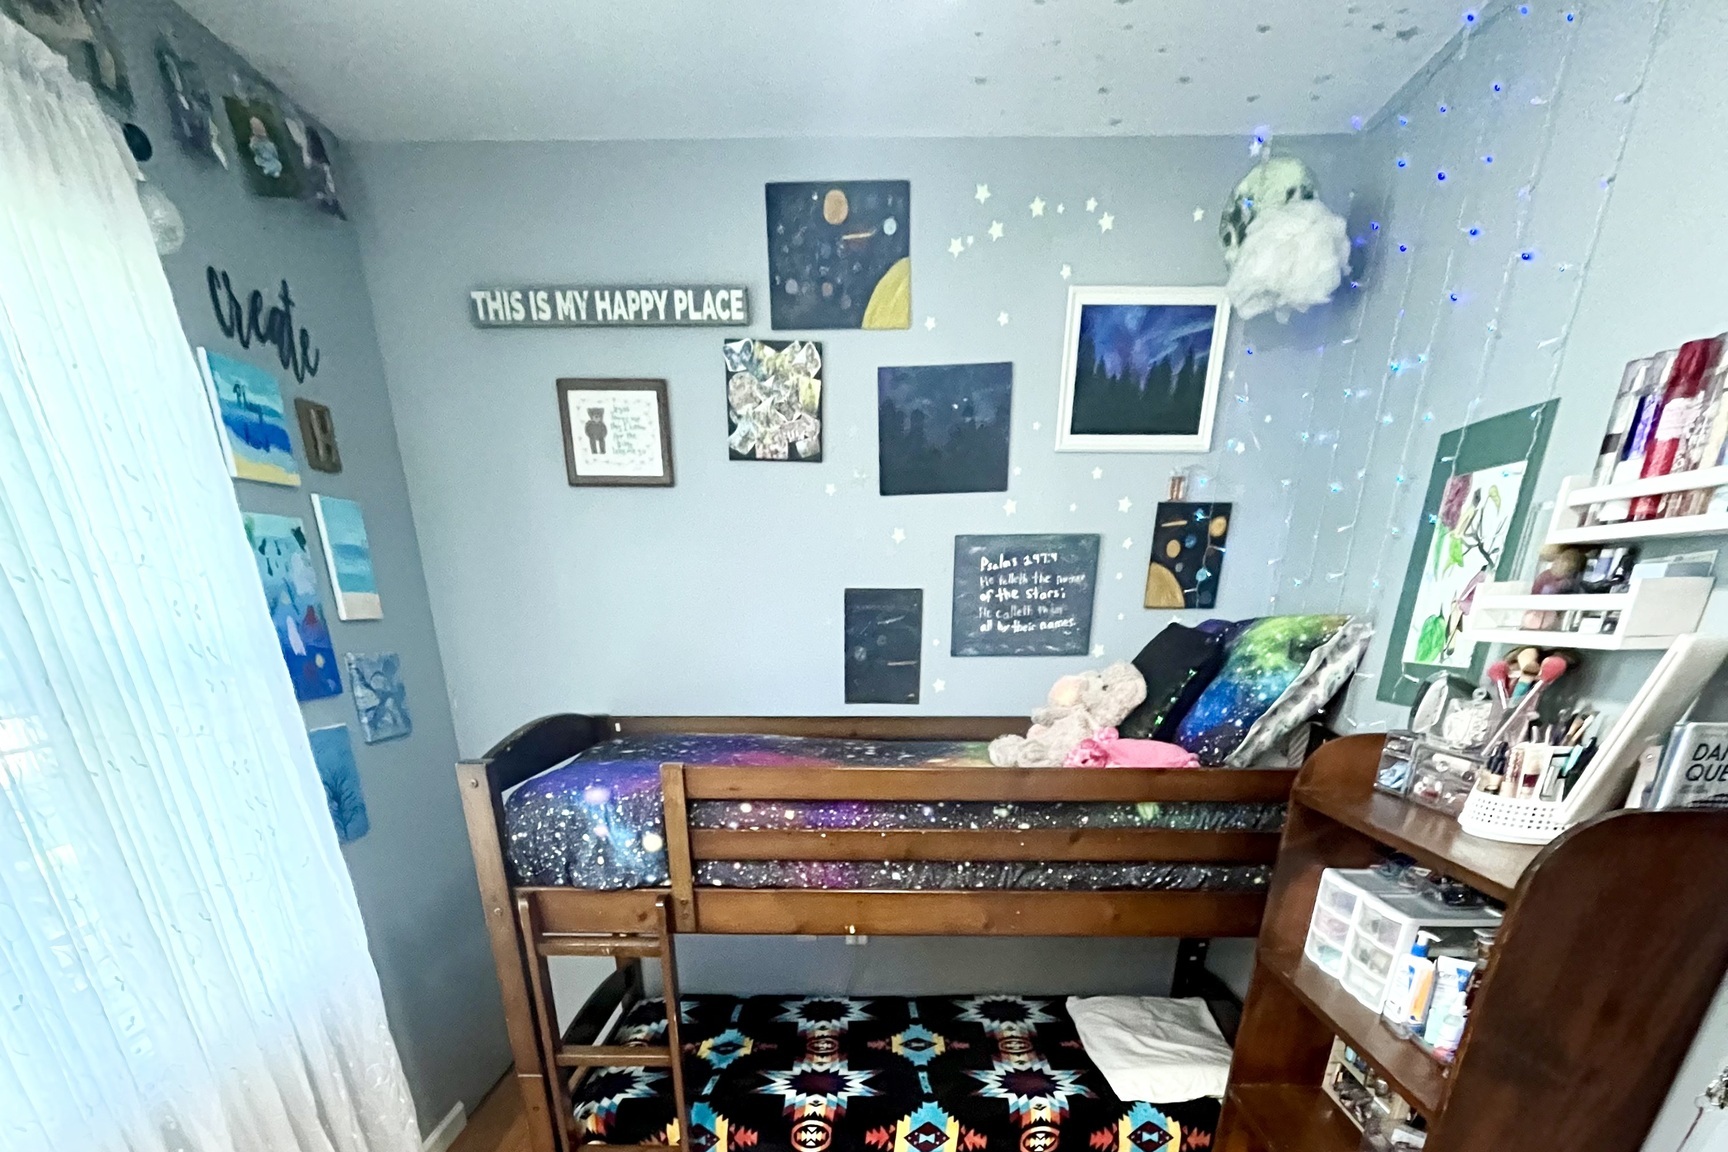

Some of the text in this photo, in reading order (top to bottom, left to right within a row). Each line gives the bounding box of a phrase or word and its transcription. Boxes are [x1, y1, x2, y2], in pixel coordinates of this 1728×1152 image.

[471, 288, 745, 322] THIS IS MY HAPPY PLACE
[206, 265, 321, 385] Create
[980, 575, 994, 587] He
[1032, 571, 1052, 585] the
[979, 588, 994, 603] of
[995, 587, 1019, 602] the
[980, 619, 993, 632] all
[997, 620, 1011, 633] by
[1011, 619, 1036, 634] their
